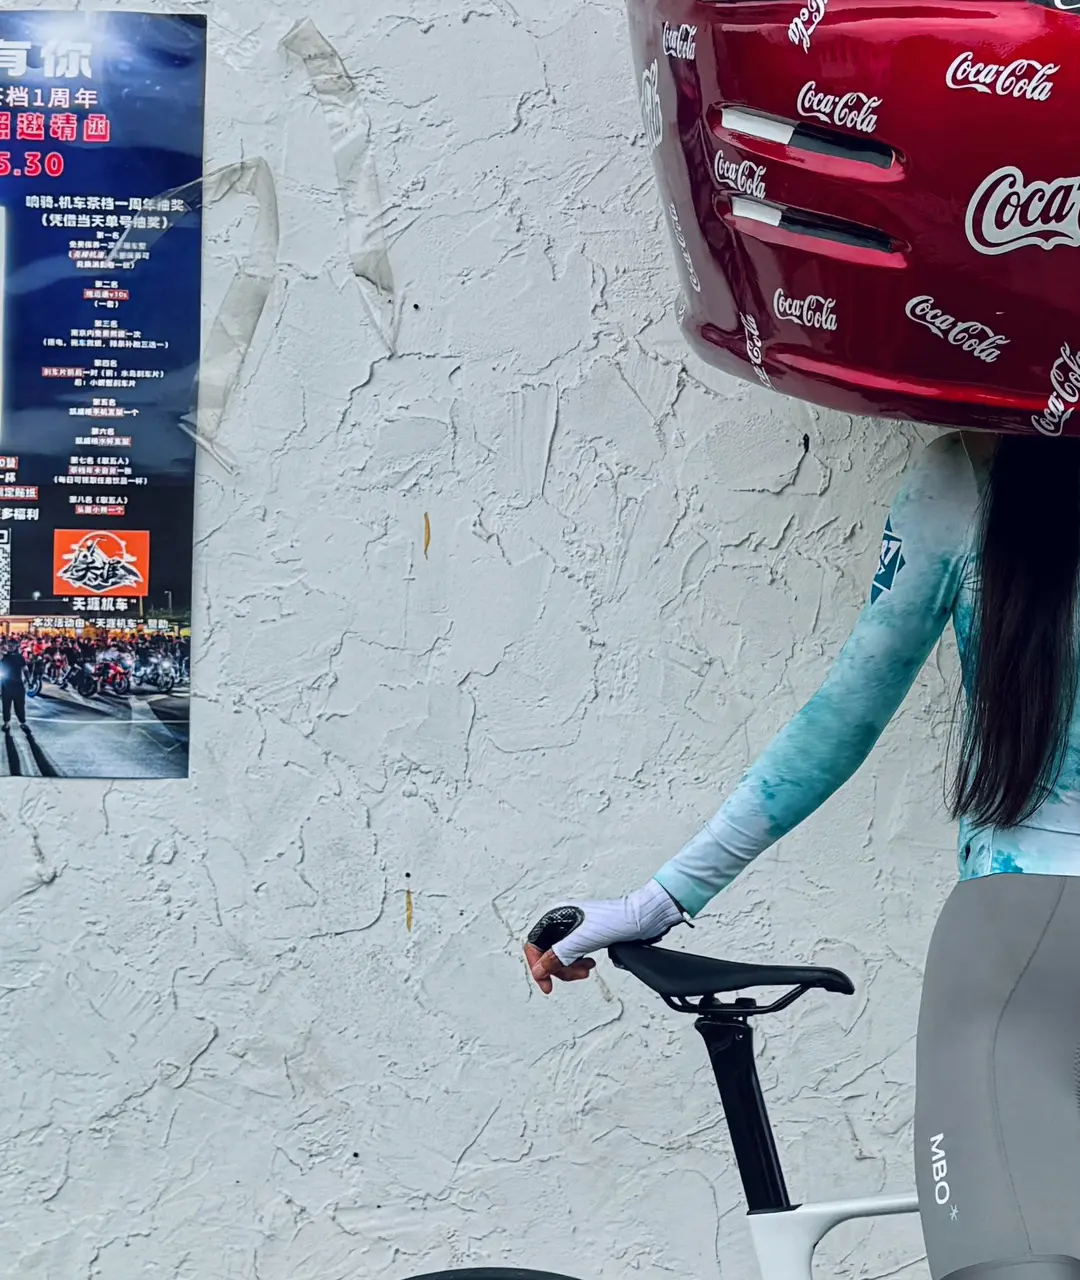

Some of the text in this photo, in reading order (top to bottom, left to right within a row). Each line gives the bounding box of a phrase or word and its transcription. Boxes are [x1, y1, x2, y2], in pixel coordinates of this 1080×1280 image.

[0, 88, 98, 108] 档1周年
[945, 51, 1061, 102] Coca-Cola
[797, 81, 883, 133] Coca-Cola
[714, 149, 767, 199] Coca-Cola
[773, 288, 838, 331] Coca-Cola
[905, 295, 1011, 363] Coca-Cola
[0, 508, 39, 520] 多福利
[930, 1132, 949, 1205] MBO
